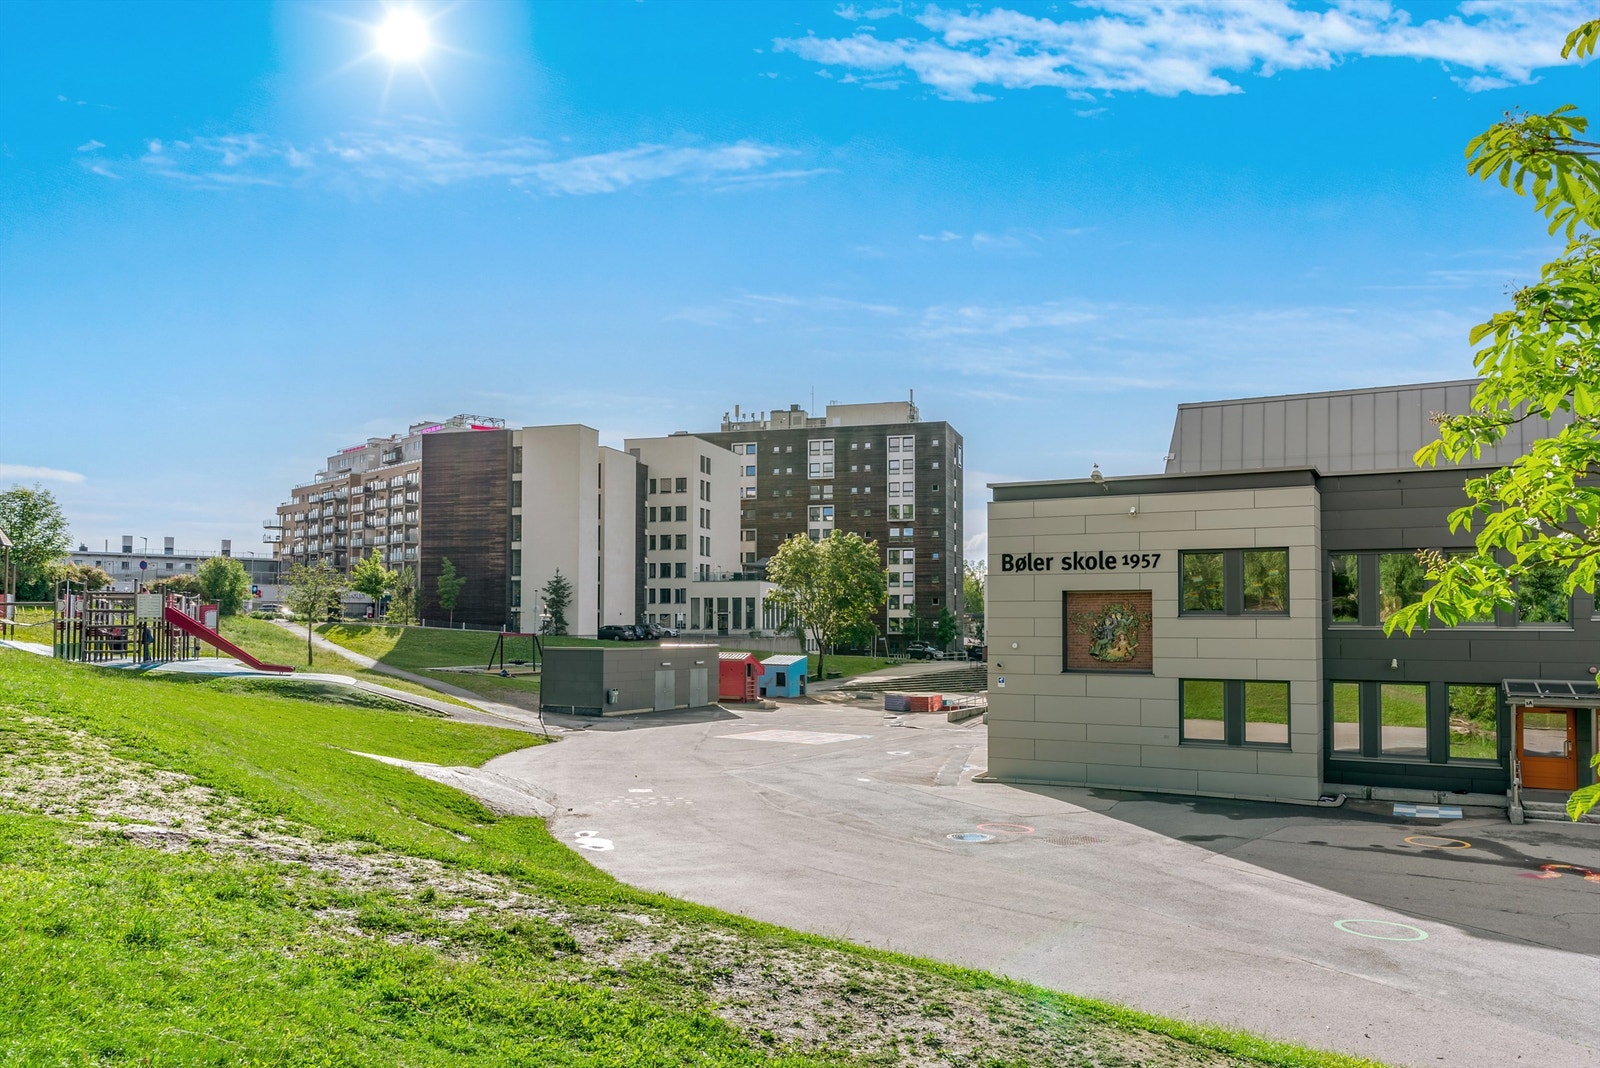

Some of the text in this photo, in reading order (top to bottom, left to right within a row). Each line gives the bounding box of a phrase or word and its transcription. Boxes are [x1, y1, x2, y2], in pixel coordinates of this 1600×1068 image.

[1001, 550, 1161, 573] Bøler skole 1957
